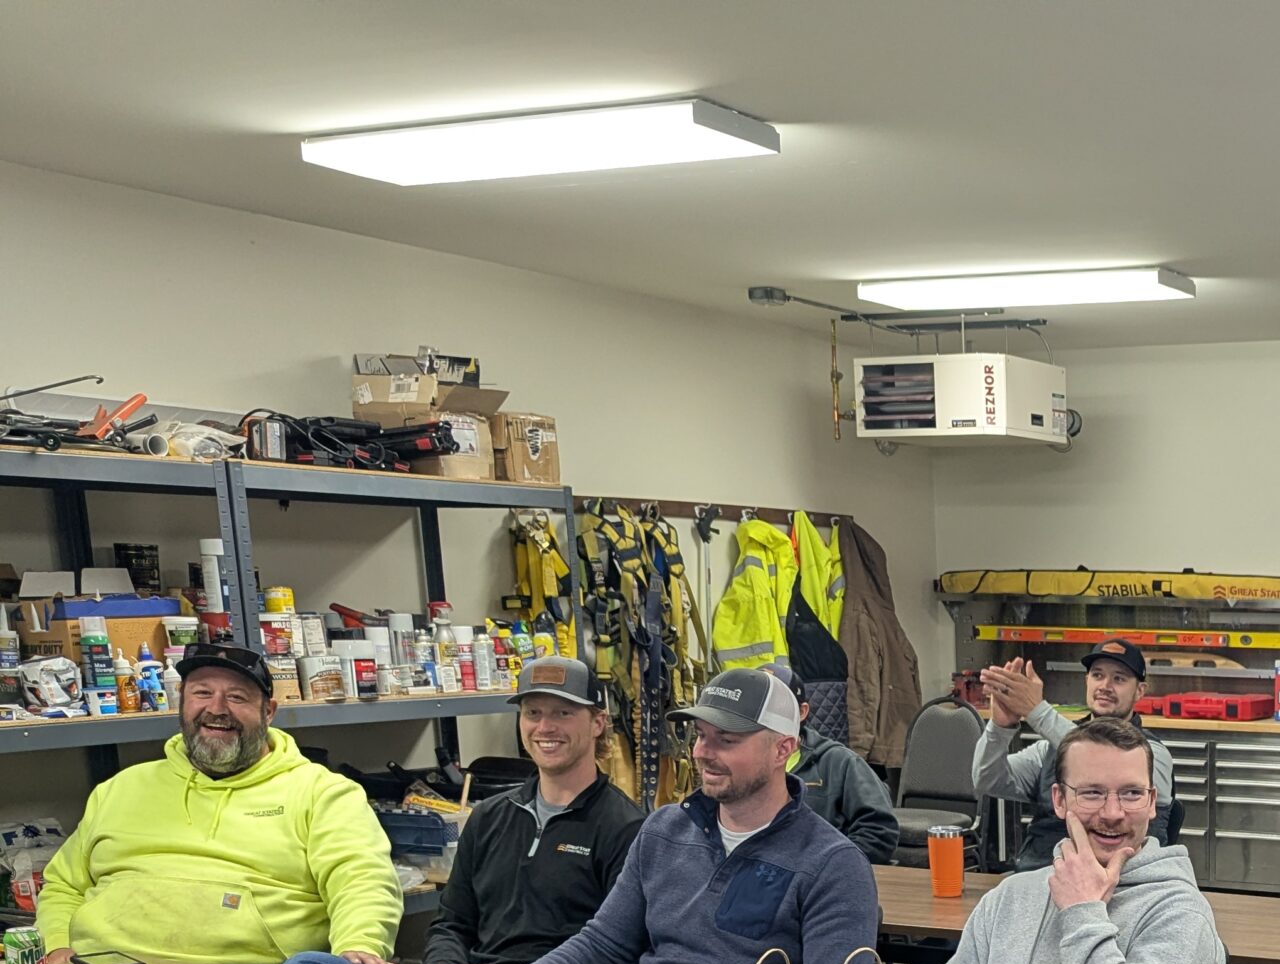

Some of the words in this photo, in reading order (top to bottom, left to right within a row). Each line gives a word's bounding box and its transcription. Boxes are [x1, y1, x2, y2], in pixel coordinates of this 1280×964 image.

[984, 364, 996, 426] REZNOR
[1097, 584, 1149, 597] STABILA
[1230, 586, 1258, 598] GREAT
